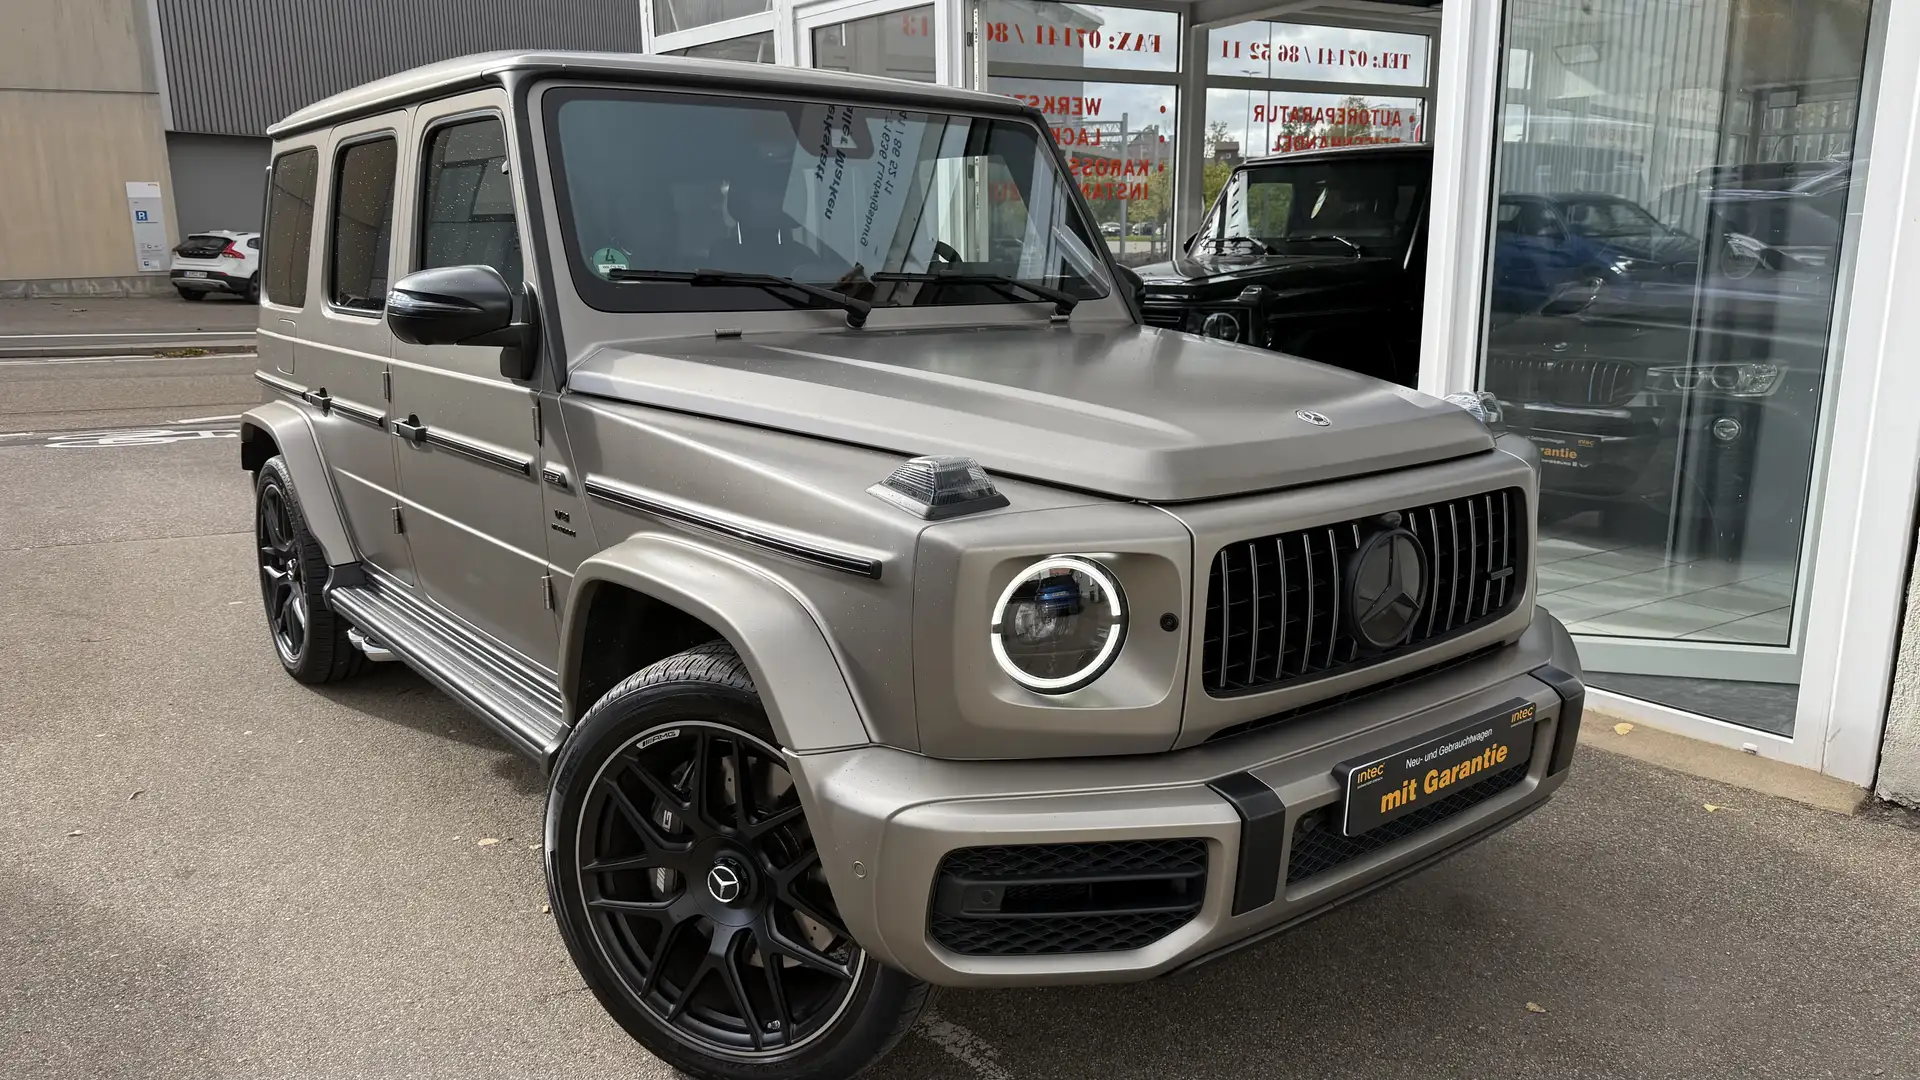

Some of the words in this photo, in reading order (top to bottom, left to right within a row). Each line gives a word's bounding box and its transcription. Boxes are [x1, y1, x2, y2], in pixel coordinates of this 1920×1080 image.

[605, 248, 617, 264] 4
[1511, 705, 1534, 724] intec
[1405, 757, 1423, 769] Neu-
[1424, 747, 1438, 762] und
[1438, 728, 1493, 756] Gebrauchtwagen
[1357, 763, 1384, 784] intec
[1380, 777, 1418, 814] mit
[1423, 743, 1508, 795] Garantie
